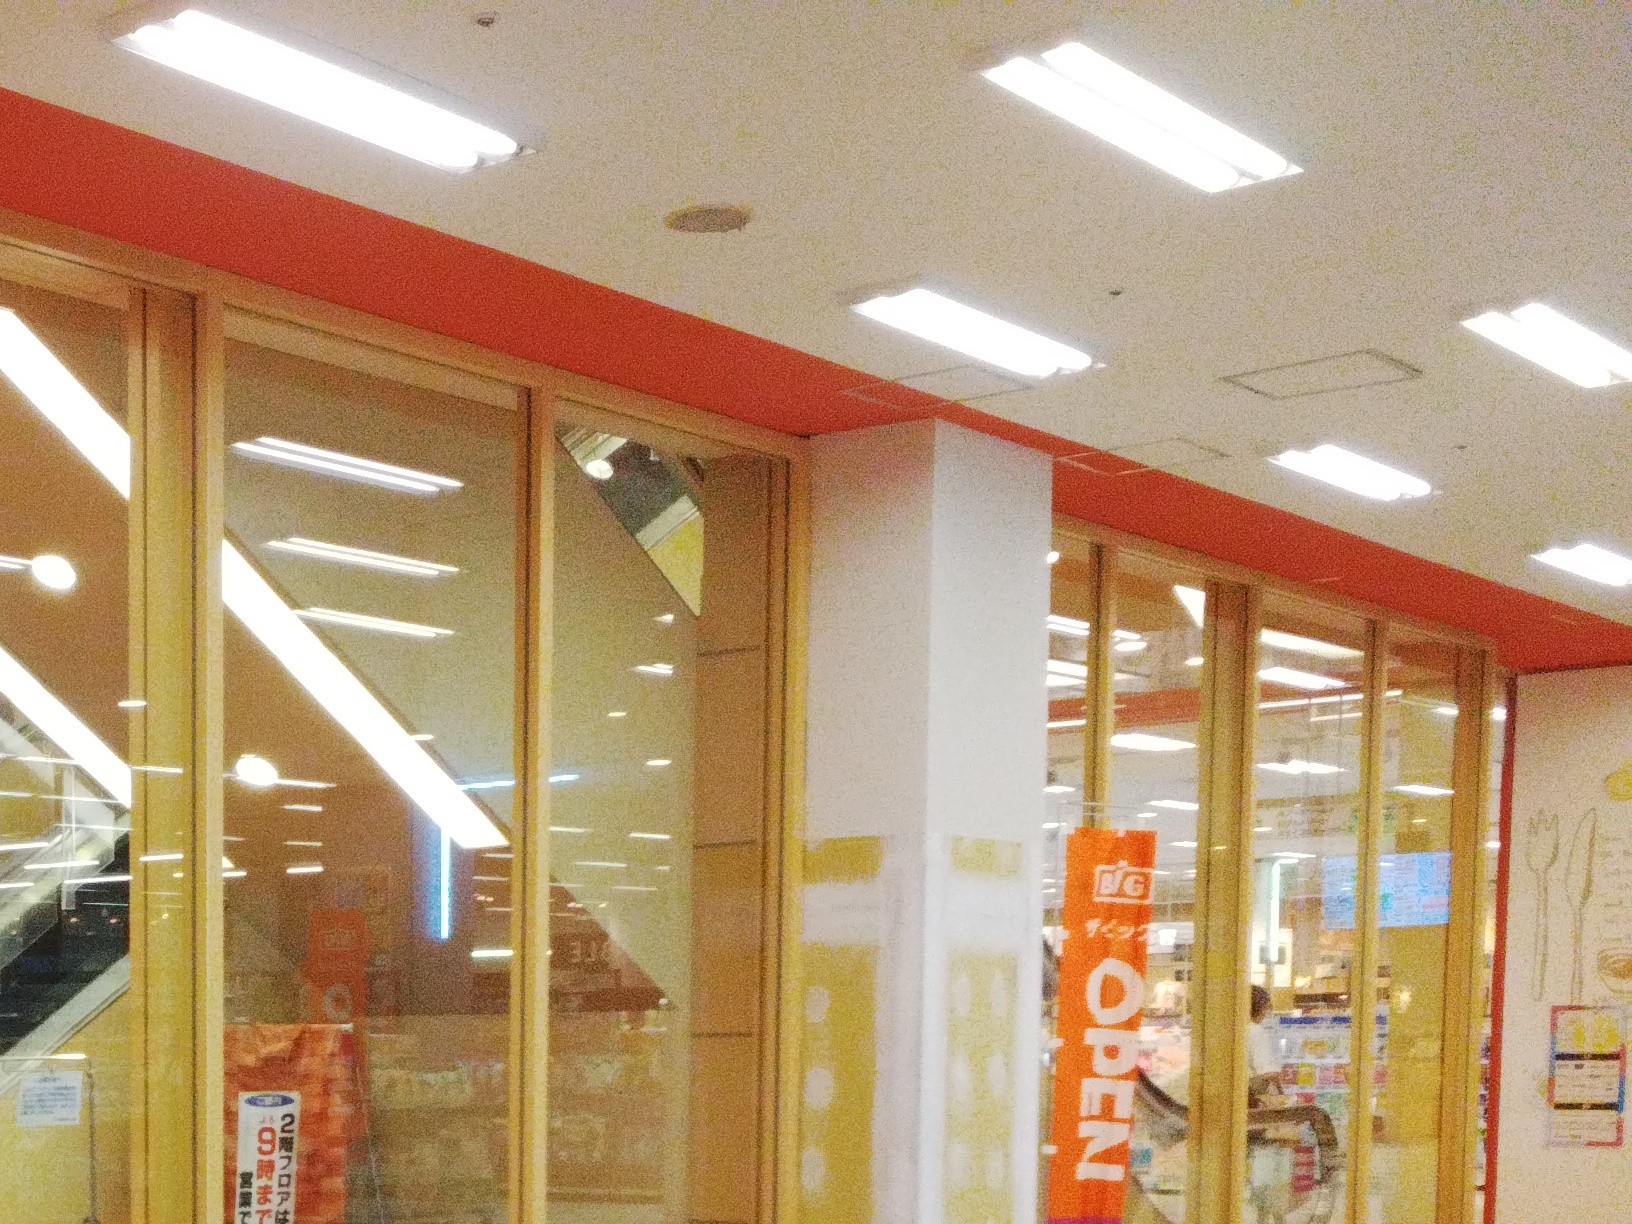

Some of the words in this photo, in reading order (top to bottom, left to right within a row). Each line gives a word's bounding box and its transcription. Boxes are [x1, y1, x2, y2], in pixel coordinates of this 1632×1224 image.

[1098, 860, 1146, 897] BIG
[1075, 957, 1145, 1182] OPEN
[274, 1113, 296, 1224] 2階フロアは
